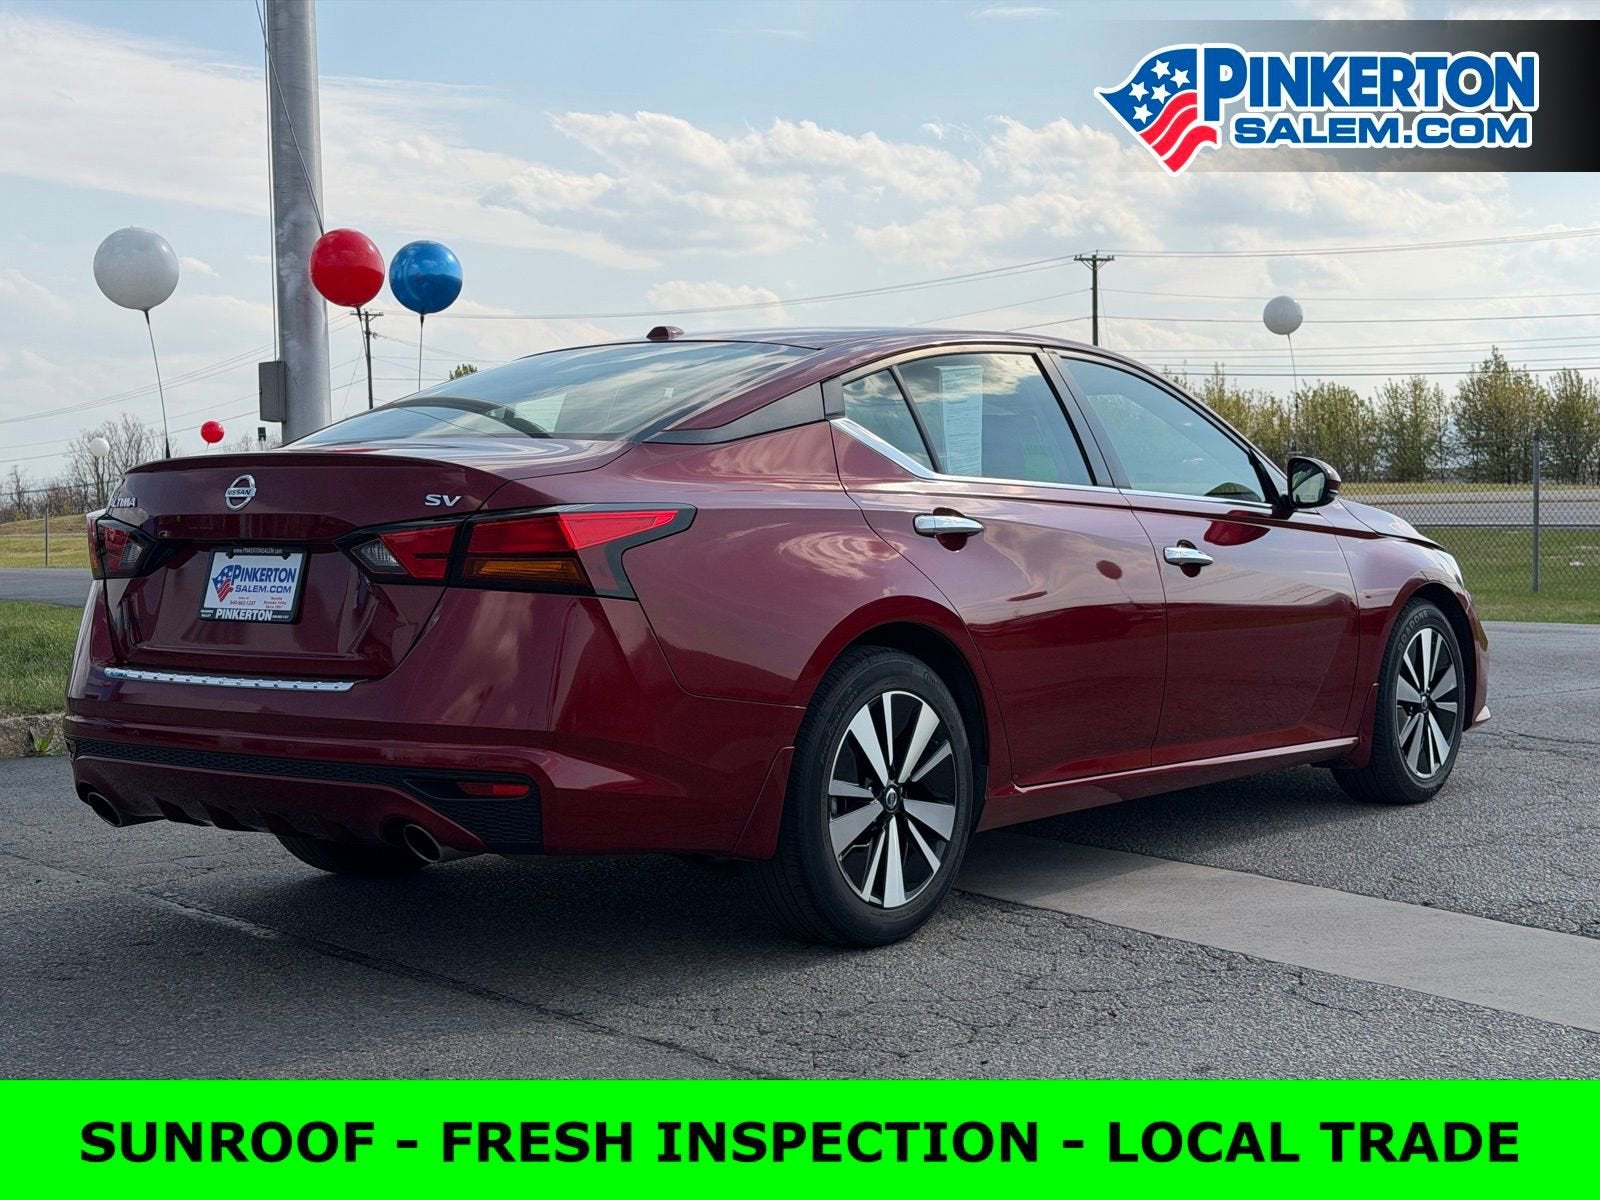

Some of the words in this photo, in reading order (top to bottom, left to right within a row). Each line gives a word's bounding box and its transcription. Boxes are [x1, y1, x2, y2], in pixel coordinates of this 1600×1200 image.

[424, 494, 462, 507] SV
[231, 564, 298, 586] PINKERTON
[234, 584, 292, 594] SALEM.COM
[215, 608, 273, 621] PINKERTON
